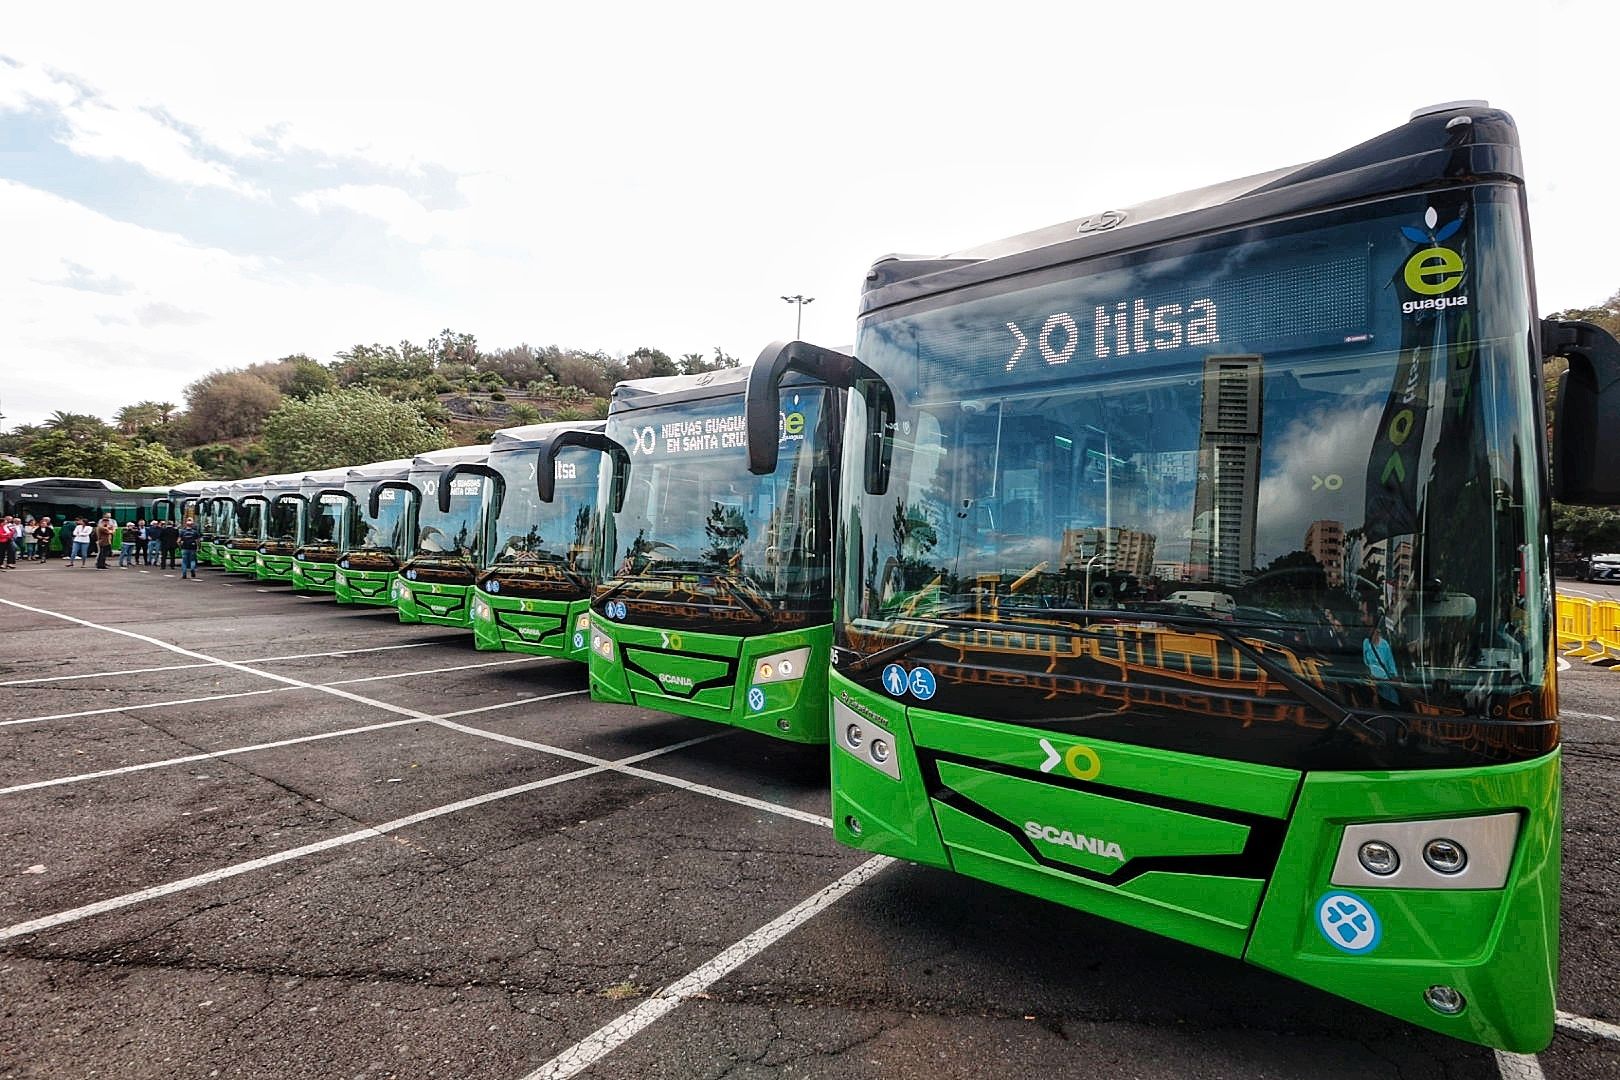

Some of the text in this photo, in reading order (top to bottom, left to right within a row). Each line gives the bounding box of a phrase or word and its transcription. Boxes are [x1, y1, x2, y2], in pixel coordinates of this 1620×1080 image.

[1404, 247, 1464, 295] e
[1402, 295, 1468, 314] guagua
[1095, 298, 1220, 358] titsa
[661, 420, 702, 439] NUEVAS
[666, 431, 747, 453] EN SANTA CRU
[658, 672, 693, 688] SCANIA
[1024, 821, 1125, 861] SCANIA
